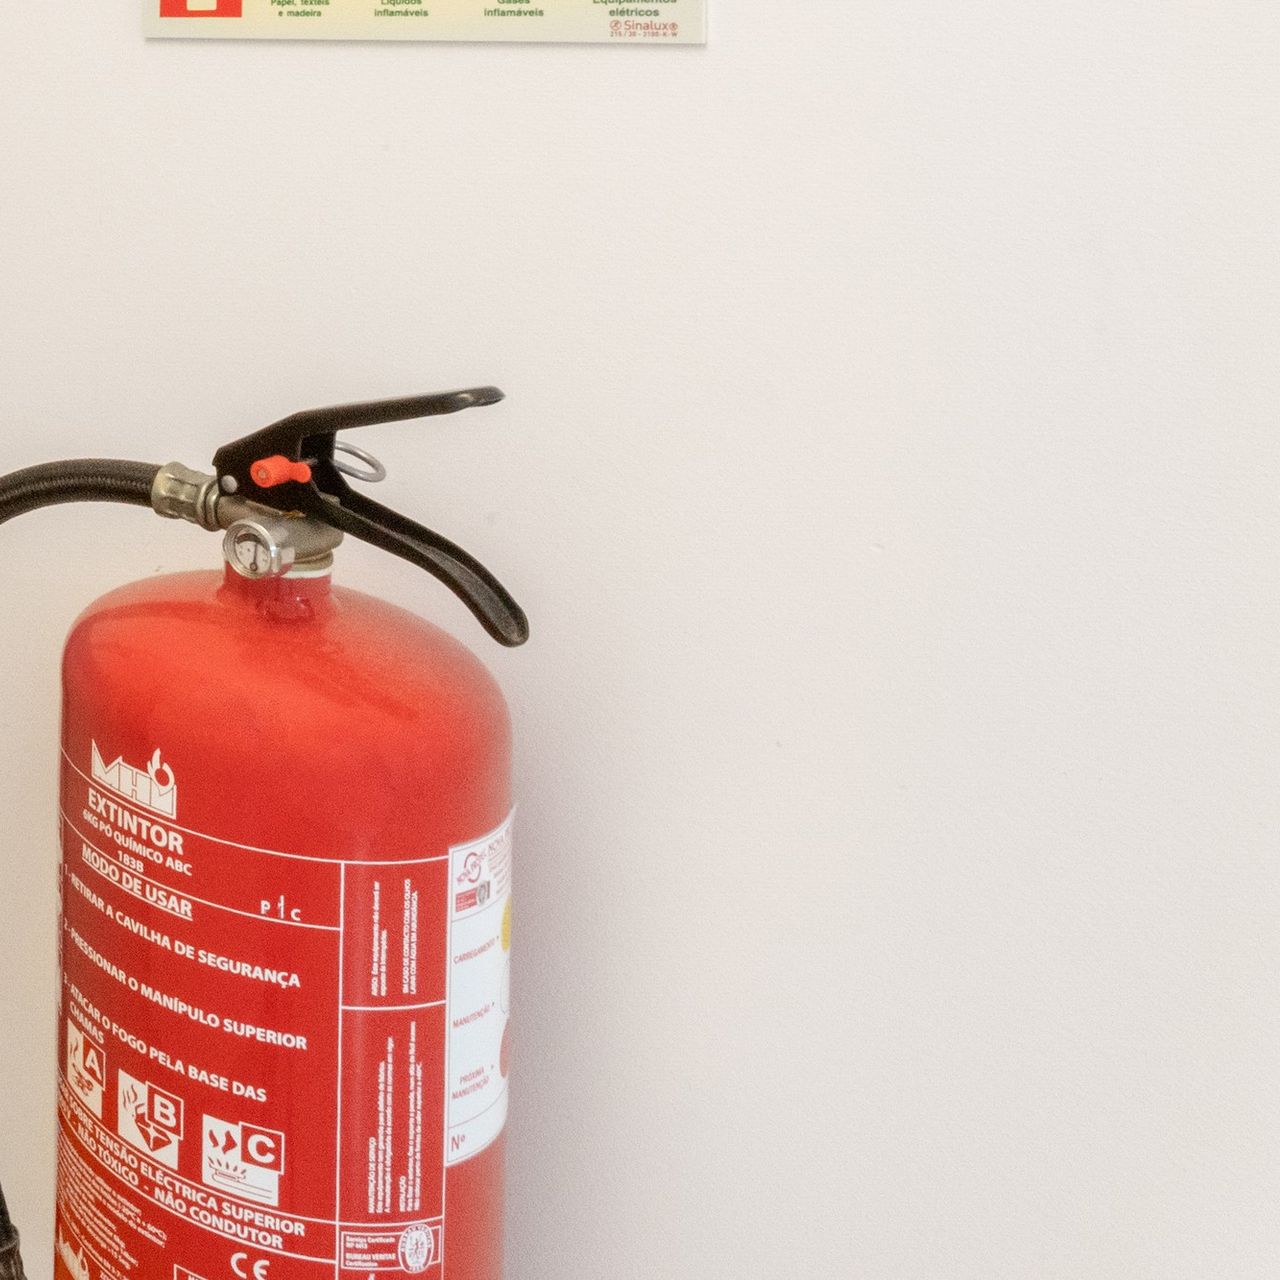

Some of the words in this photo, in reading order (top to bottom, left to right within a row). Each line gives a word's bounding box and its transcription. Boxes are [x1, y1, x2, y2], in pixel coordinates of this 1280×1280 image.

[287, 9, 322, 17] madeira
[374, 8, 429, 17] inflamáveis
[484, 7, 544, 17] inflamáveis
[609, 7, 659, 17] elétricos
[83, 809, 98, 828] 6KG
[99, 819, 112, 837] PÓ
[113, 830, 163, 864] QUÍMICO
[166, 856, 193, 876] ABC
[89, 787, 183, 856] EXTINTOR
[82, 843, 120, 882] MODO
[122, 872, 142, 895] DE
[145, 883, 192, 917] USAR
[117, 850, 144, 872] 183B
[71, 873, 104, 913] RETIRAR
[106, 905, 114, 919] A
[116, 911, 171, 950] CAVILHA
[175, 940, 195, 960] DE
[198, 949, 301, 988] SEGURANÇA
[70, 927, 126, 985] PRESSIONAR
[128, 976, 138, 991] O
[140, 981, 220, 1028] MANÍPULO
[224, 1018, 307, 1050] SUPERIOR
[69, 1001, 104, 1045] CHAMAS
[70, 983, 101, 1023] ATACAR
[102, 1014, 111, 1030] O
[112, 1021, 147, 1055] FOGO
[149, 1046, 184, 1074] PELA
[188, 1064, 228, 1091] BASE
[232, 1080, 267, 1102] DAS
[85, 1047, 103, 1081] A
[153, 1093, 176, 1127] B
[247, 1134, 276, 1163] C
[78, 1122, 97, 1151] NÃO
[97, 1144, 138, 1186] TÓXICO
[154, 1186, 186, 1214] NÃO
[189, 1206, 284, 1250] CONDUTOR
[94, 1126, 138, 1169] TENSÃO
[140, 1158, 218, 1212] ELÉCTRICA
[222, 1201, 305, 1237] SUPERIOR
